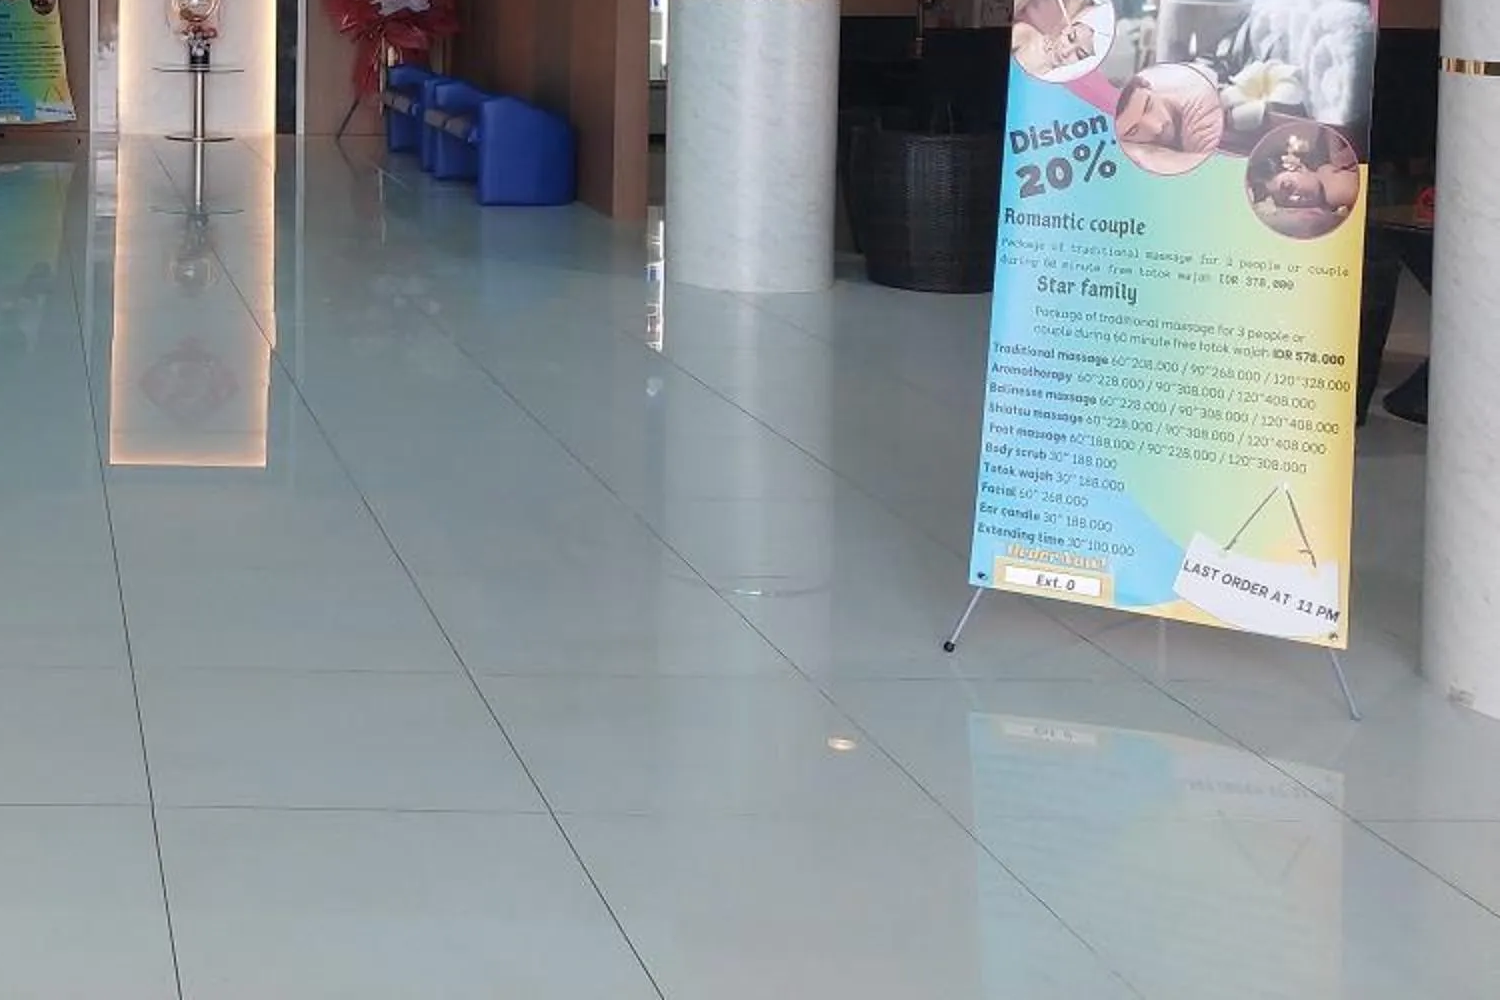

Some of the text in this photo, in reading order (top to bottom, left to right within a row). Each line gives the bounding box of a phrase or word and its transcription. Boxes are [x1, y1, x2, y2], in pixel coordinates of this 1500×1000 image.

[1010, 115, 1109, 154] Diskon
[1015, 140, 1117, 199] 20%
[1004, 207, 1146, 239] Romantic couple
[1036, 275, 1138, 305] Star family
[1035, 305, 1083, 322] Package
[993, 342, 1055, 359] Traditional
[1057, 350, 1109, 367] massage
[1272, 349, 1293, 361] IDR
[991, 362, 1073, 382] Aromatherapy
[1045, 390, 1097, 407] massage
[988, 402, 1031, 417] Shiatsu
[1033, 408, 1083, 425] massage
[989, 422, 1014, 435] Foot
[1016, 427, 1067, 444] massage
[985, 442, 1012, 458] Body
[1015, 447, 1047, 460] scrub
[1019, 468, 1054, 483] wajah
[981, 481, 1016, 498] Facial
[979, 502, 999, 515] Ear
[1001, 504, 1041, 521] candle
[977, 522, 1036, 544] Extending
[1038, 531, 1065, 547] time
[1035, 574, 1062, 589] Ext.
[1183, 560, 1341, 623] LAST ORDER AT 11 PM
